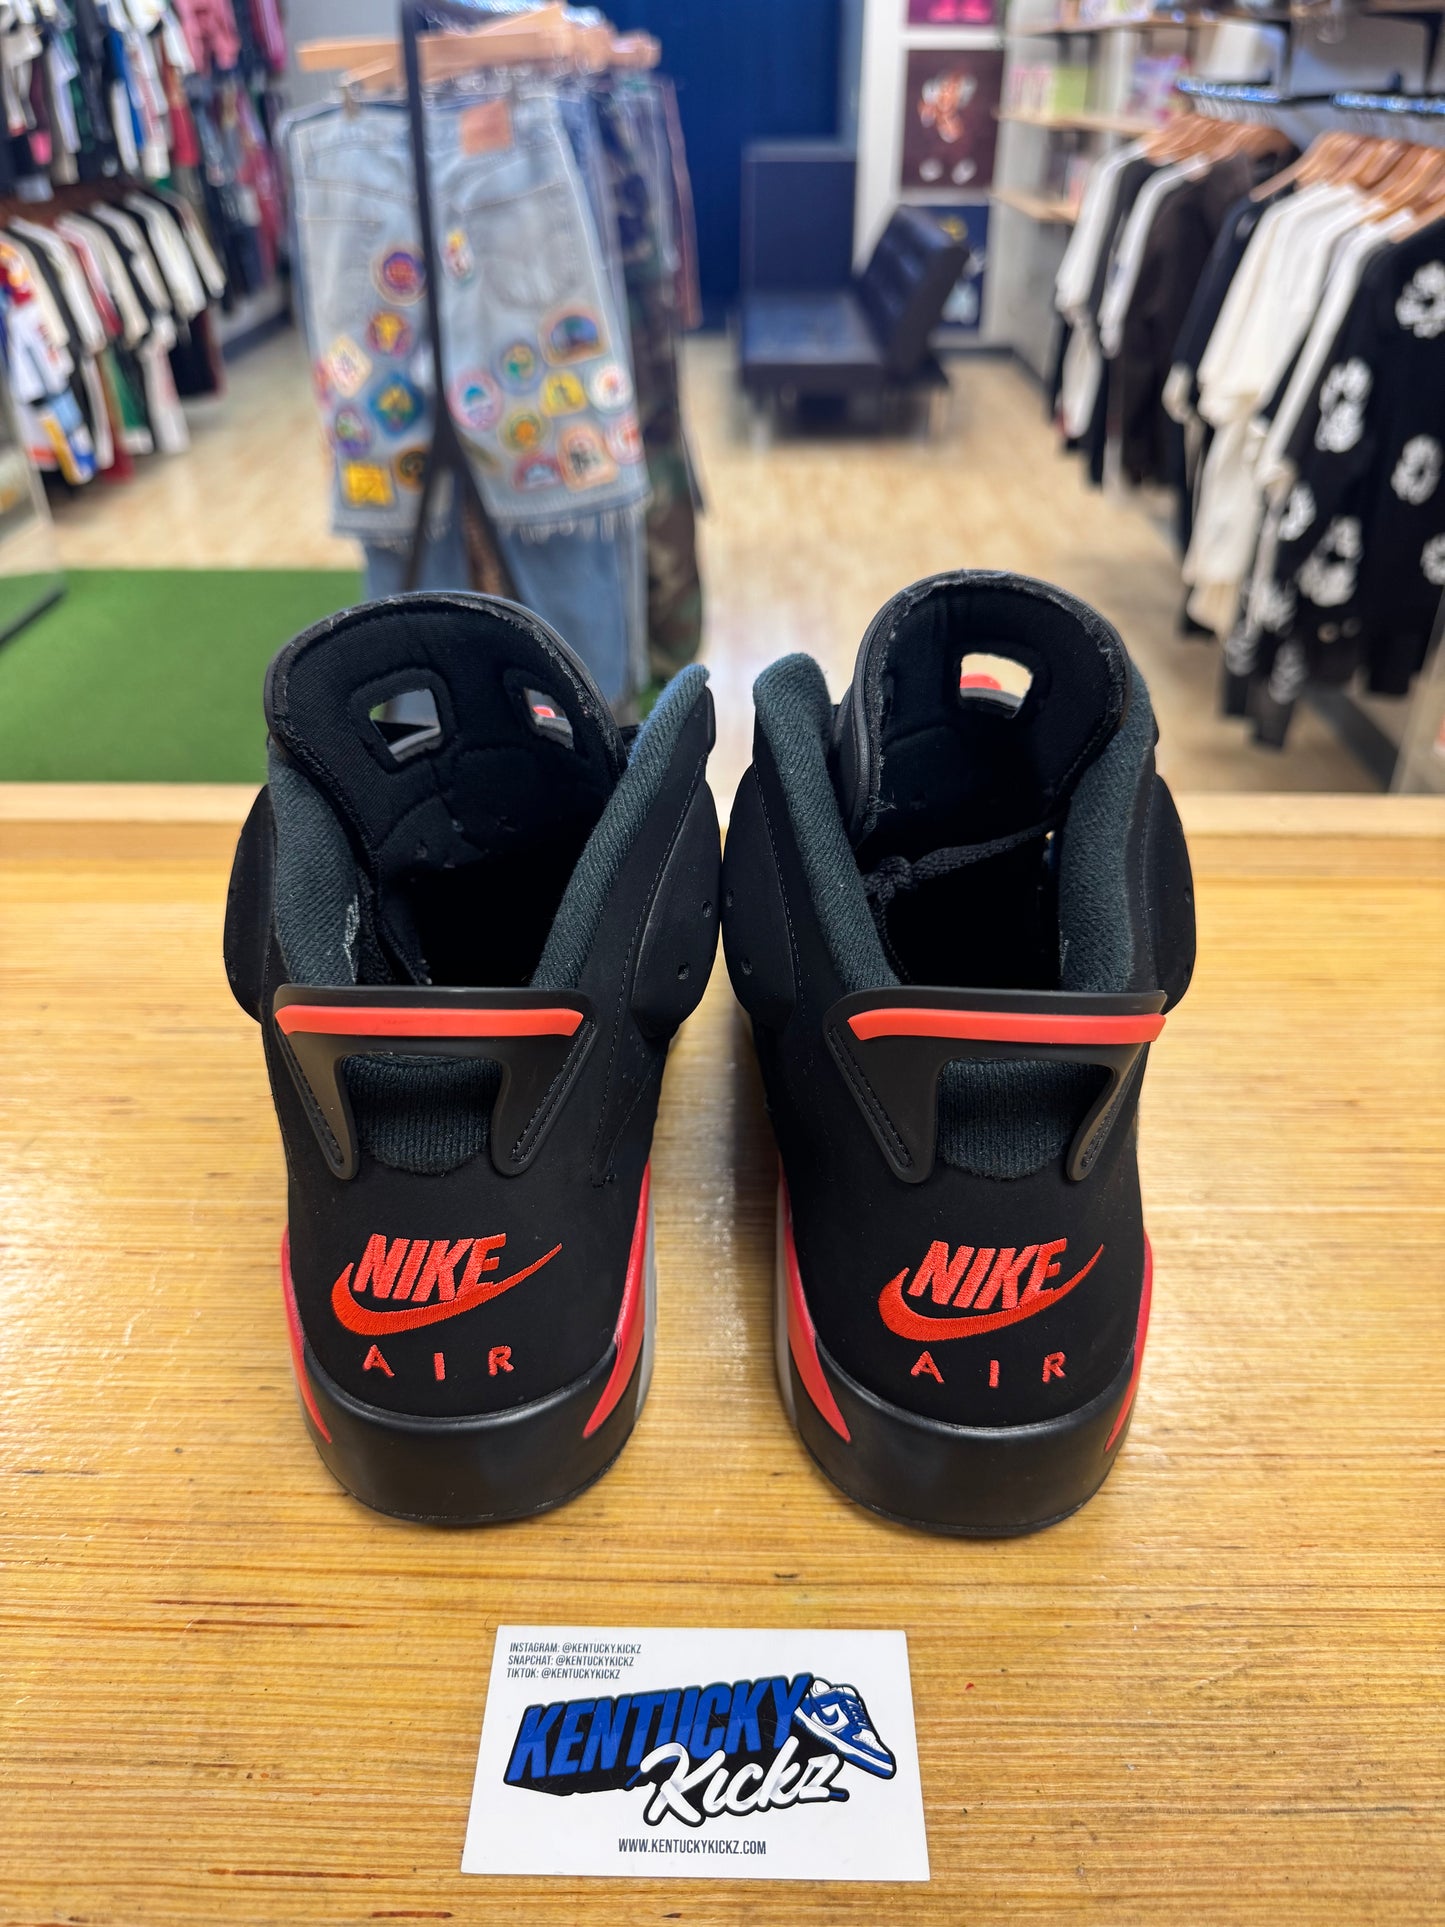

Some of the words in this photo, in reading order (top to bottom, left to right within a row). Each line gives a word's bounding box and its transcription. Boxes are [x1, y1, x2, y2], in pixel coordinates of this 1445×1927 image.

[353, 1233, 507, 1302] NIKE
[907, 1238, 1068, 1310] NIKE
[363, 1344, 515, 1381] AIR
[910, 1350, 1067, 1388] AIR
[508, 1654, 554, 1666] SNAPCHAT:
[555, 1655, 634, 1667] @KENTUCKYKICKZ
[509, 1642, 560, 1653] INSTAGRAM:
[562, 1642, 642, 1654] @KENTUCKY.KICKZ
[506, 1667, 539, 1679] TIKTOK:
[541, 1667, 621, 1680] @KENTUCKYKICKZ
[506, 1674, 813, 1782] KENTUCKY
[640, 1735, 841, 1824] Kickz
[618, 1838, 767, 1855] WWW.KENTUCKYKICKZ.COM
